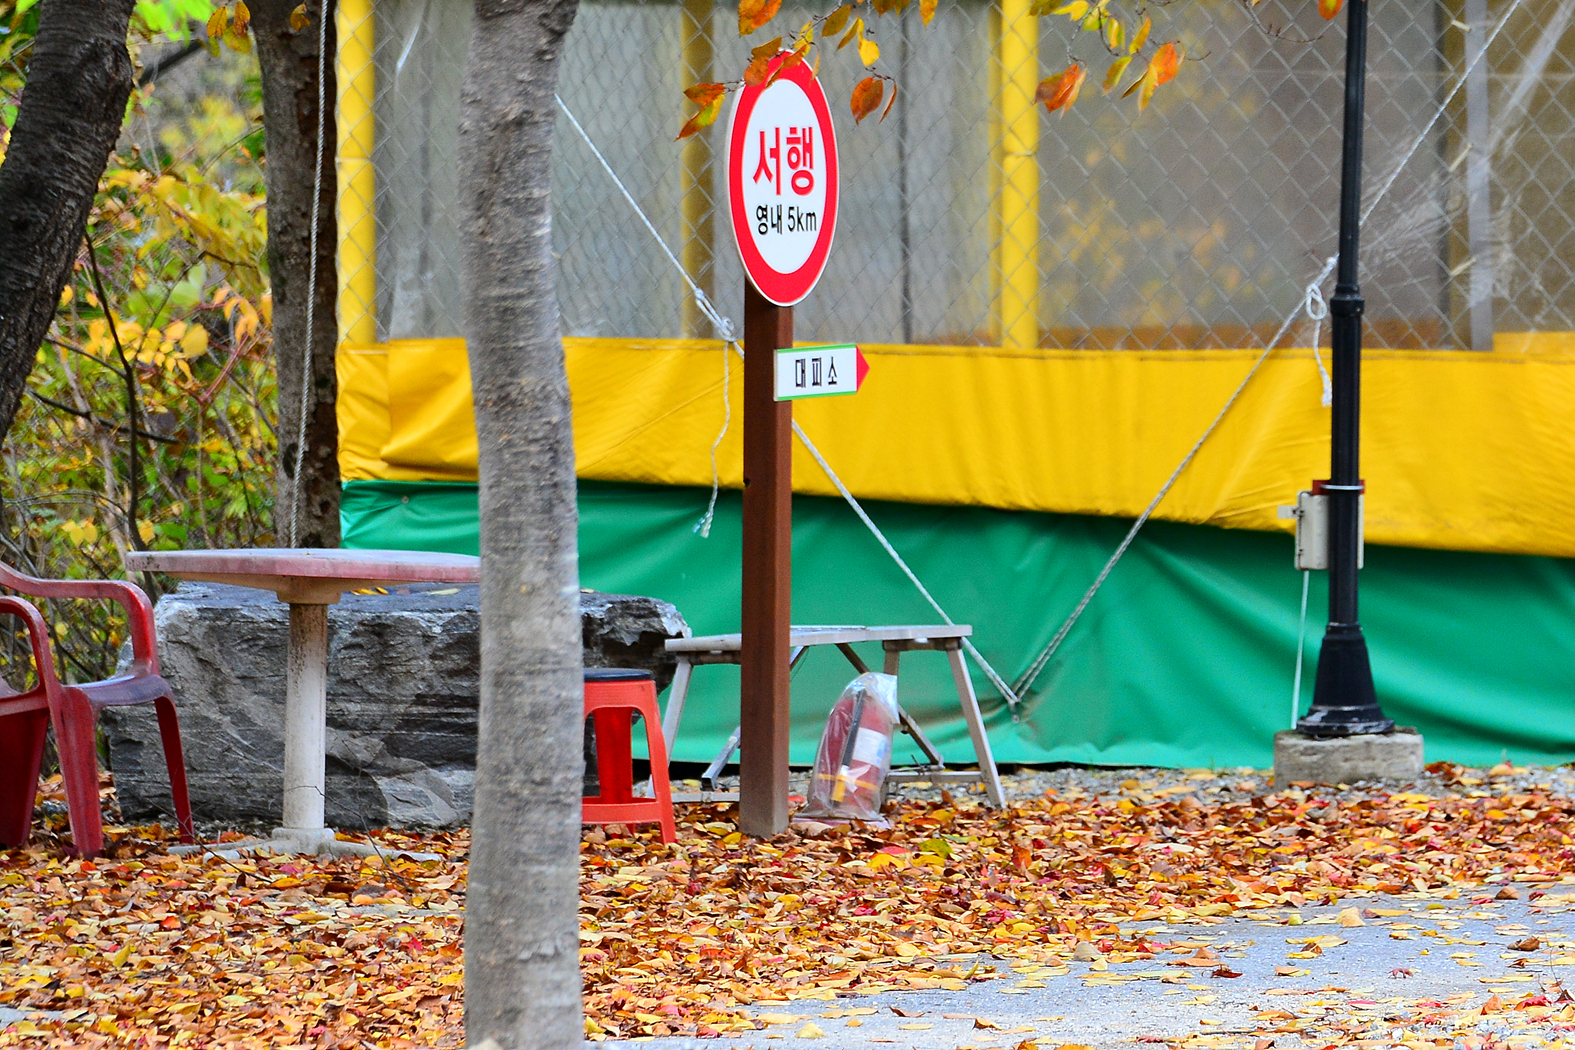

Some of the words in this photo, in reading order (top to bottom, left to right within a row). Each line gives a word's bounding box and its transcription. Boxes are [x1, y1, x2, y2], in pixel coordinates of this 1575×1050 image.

[753, 126, 815, 196] 서행
[756, 204, 783, 235] 영내
[787, 206, 817, 233] 5km
[795, 356, 838, 388] 대피소
